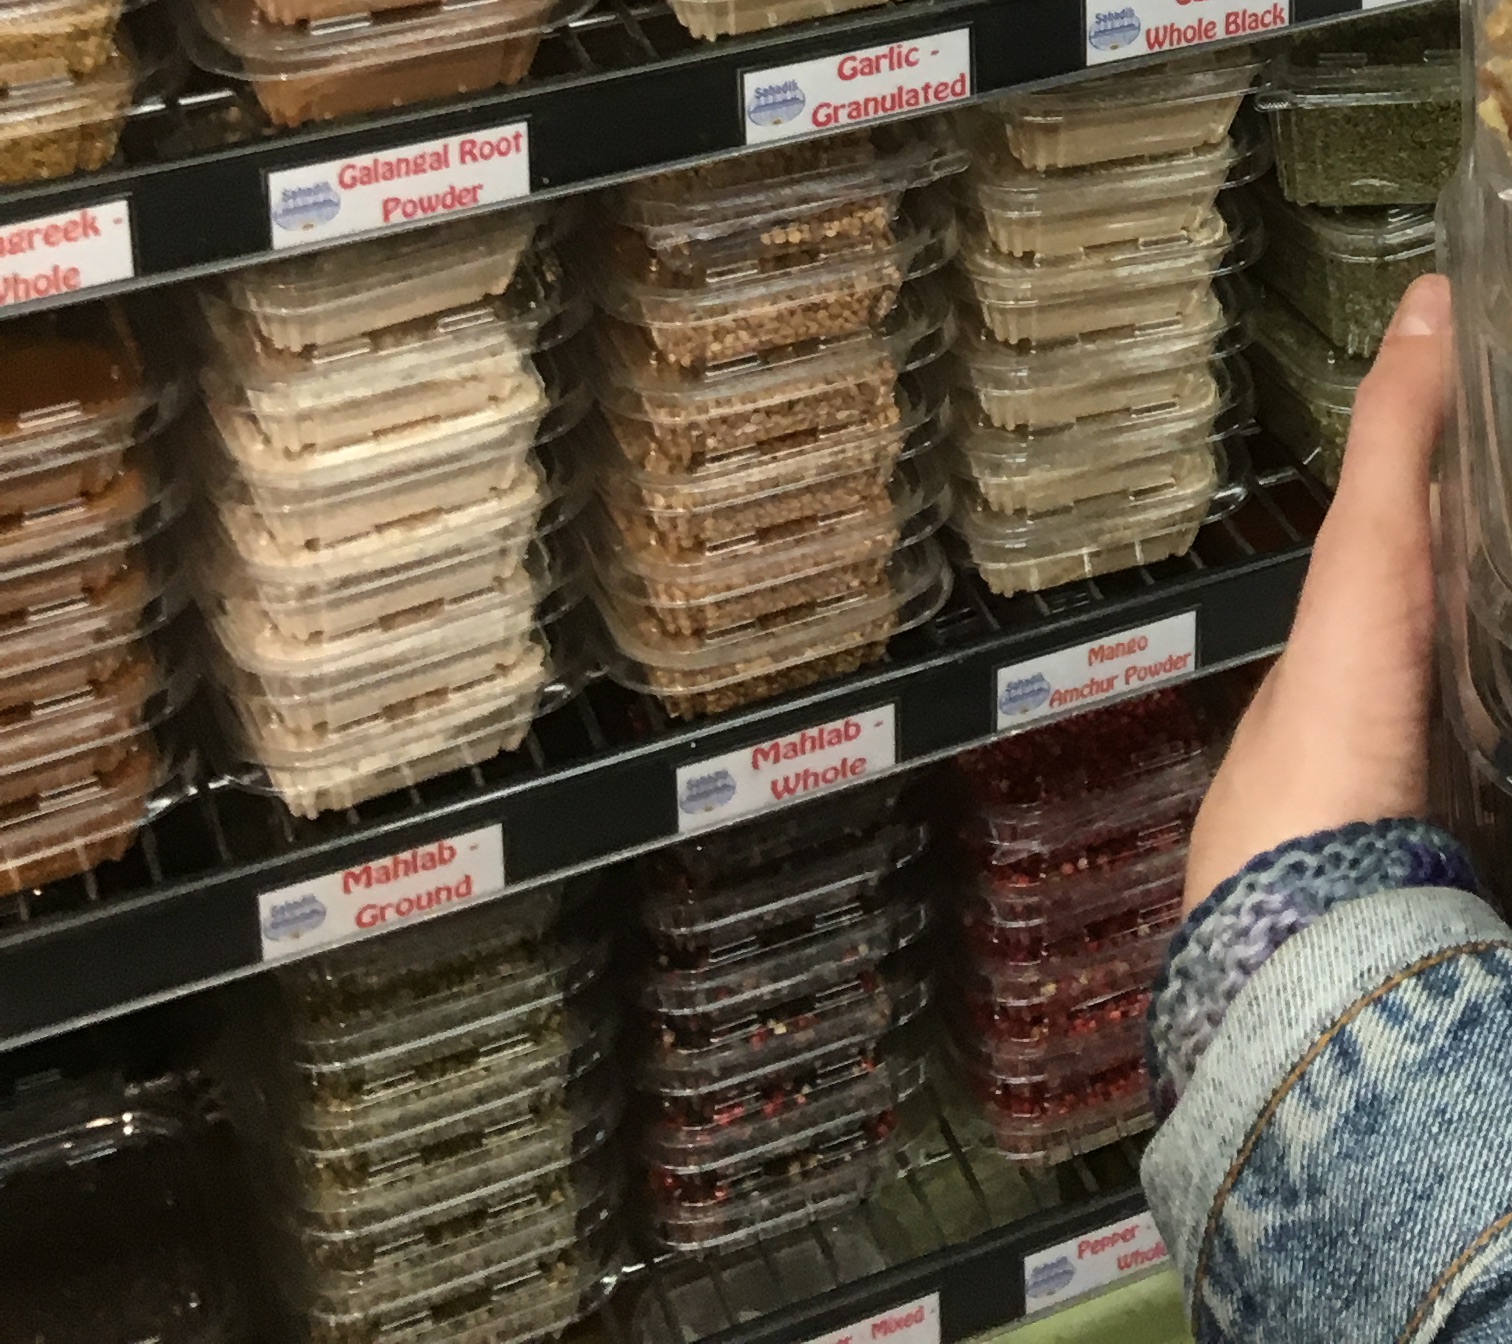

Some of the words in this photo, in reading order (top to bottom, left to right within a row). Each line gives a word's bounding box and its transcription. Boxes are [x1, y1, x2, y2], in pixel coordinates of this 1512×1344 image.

[1145, 17, 1218, 52] Whole
[1224, 2, 1286, 35] Black
[837, 42, 919, 81] Garlic
[811, 73, 967, 128] Granulated
[338, 143, 451, 192] Galangal
[459, 129, 524, 165] Root
[381, 180, 484, 223] Powder
[1087, 634, 1149, 667] Mango
[1049, 672, 1119, 708] Amchur
[1124, 651, 1192, 686] Powder
[752, 717, 862, 770] Mahlab
[770, 756, 867, 801] Whole
[341, 839, 457, 894] Mahlab
[354, 874, 472, 930] Ground
[1077, 1224, 1140, 1260] Pepper
[871, 1305, 925, 1340] Mixed
